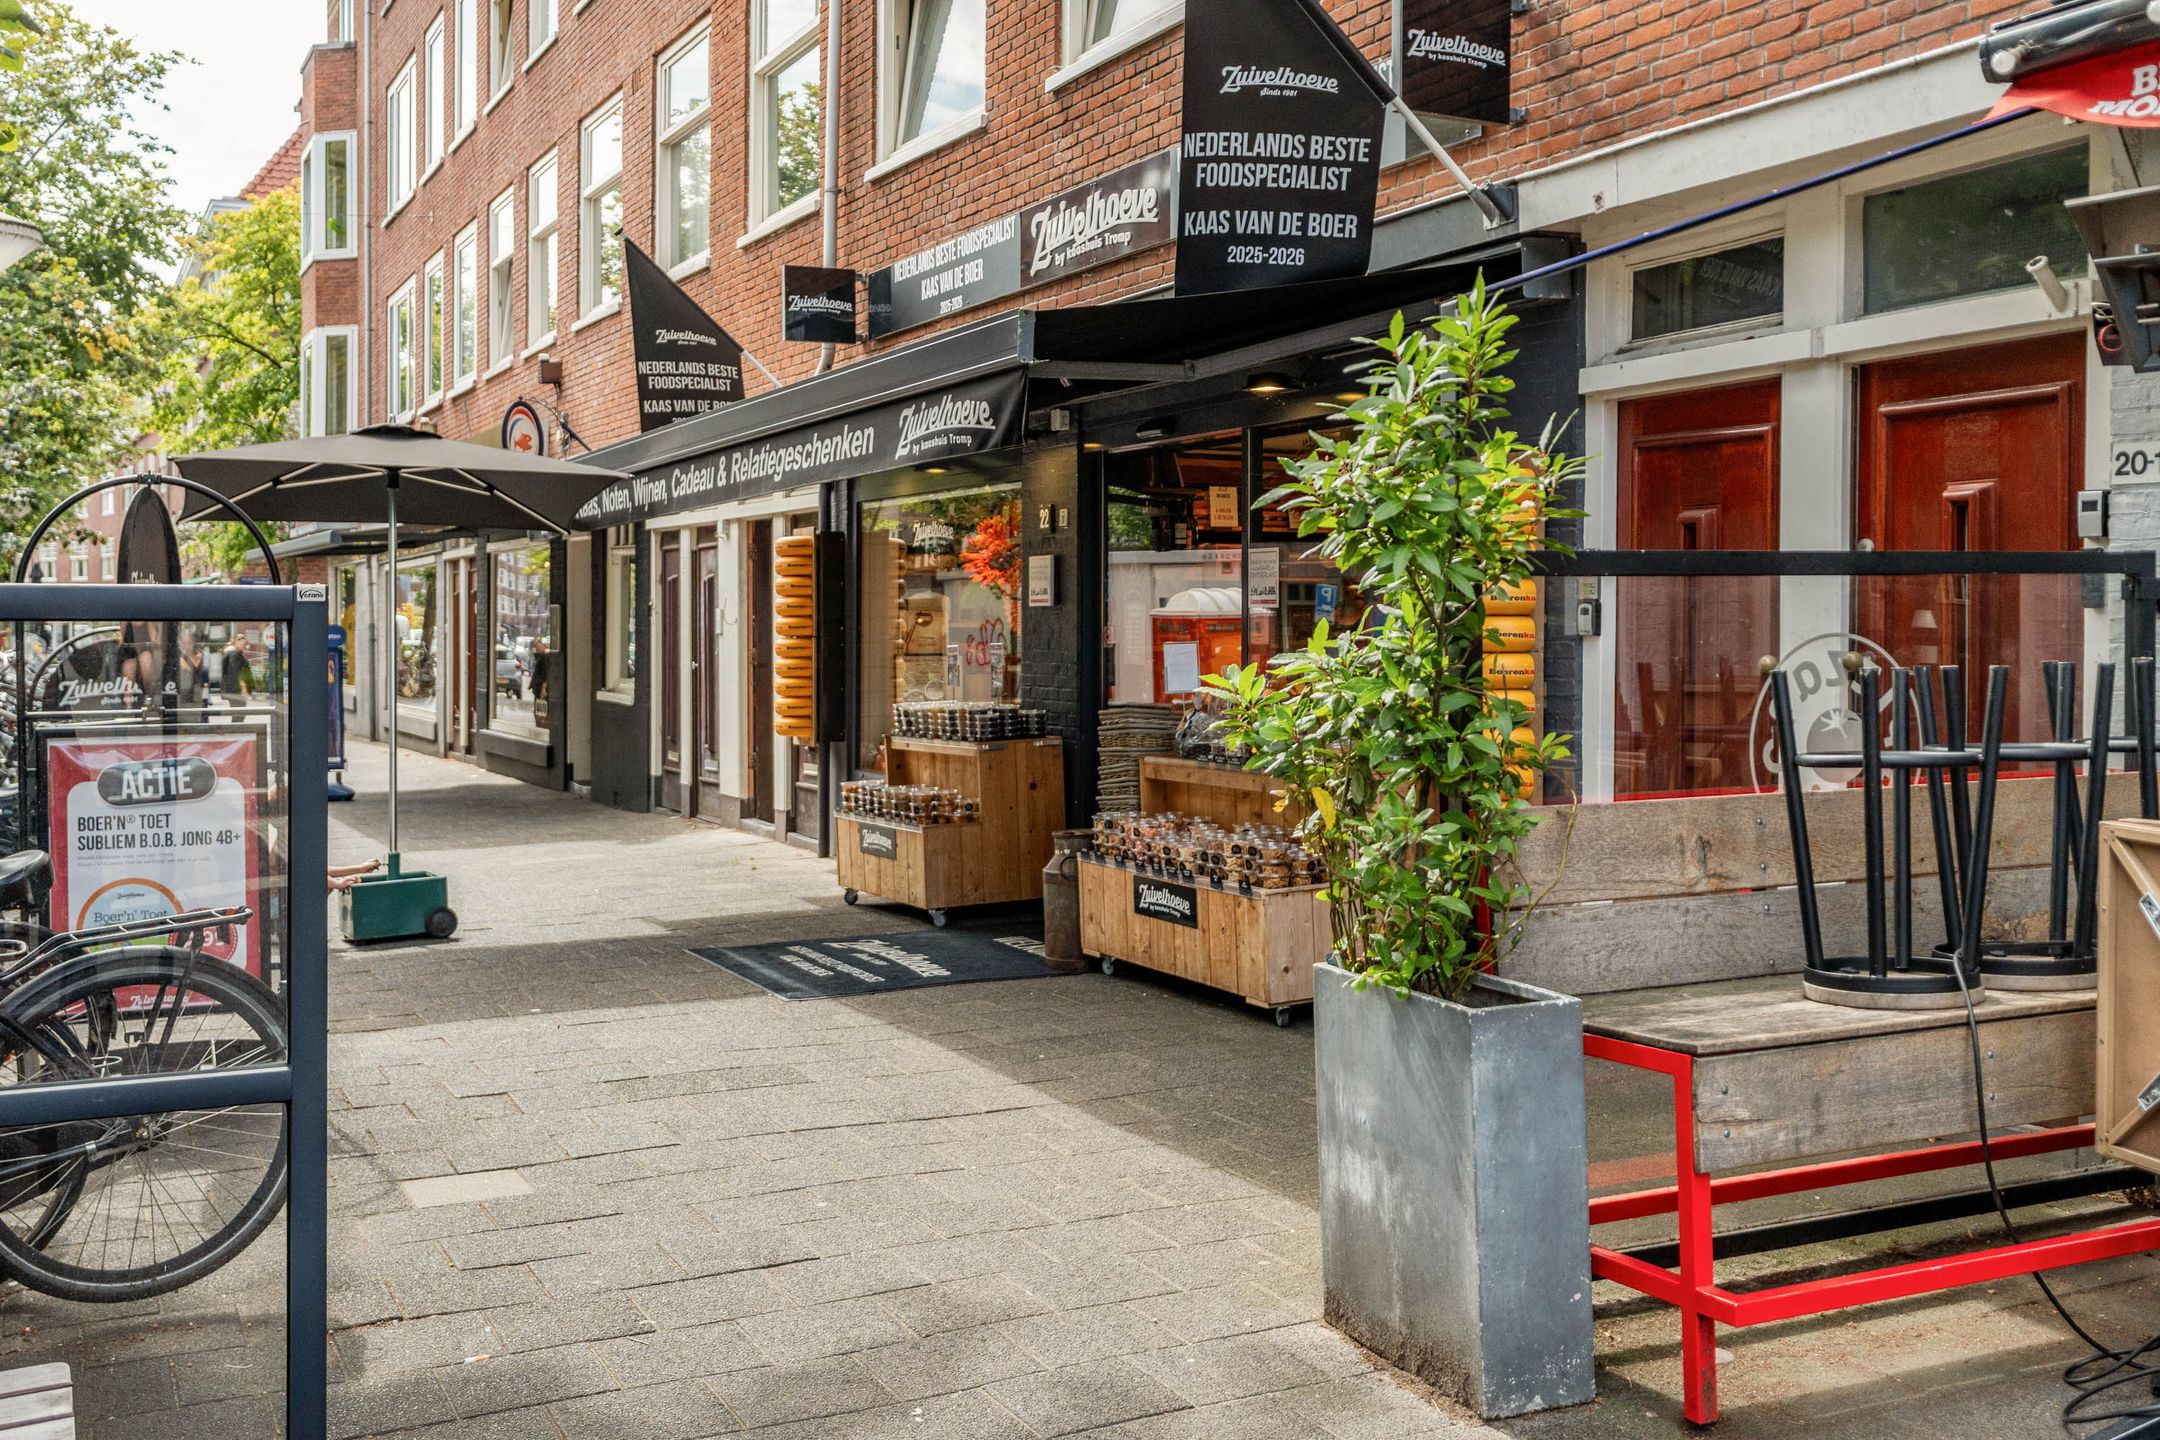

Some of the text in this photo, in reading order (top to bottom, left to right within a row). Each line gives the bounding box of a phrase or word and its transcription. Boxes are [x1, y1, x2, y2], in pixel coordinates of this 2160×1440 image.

[1407, 28, 1506, 67] Zuivelhoeve
[1219, 65, 1339, 94] Zuivelhoeve
[2131, 64, 2160, 97] B
[1184, 131, 1371, 162] NEDERLANDS BESTE
[1196, 162, 1352, 191] FOODSPECIALIST
[1029, 187, 1160, 278] Zuivelhoeve
[1184, 209, 1358, 239] KAAS VAN DE BOER
[894, 215, 1016, 284] NEDERLANDS BESTE FOODSPECIALIST
[1055, 231, 1132, 267] by kaashuis Tromp
[1227, 245, 1305, 266] 2025-2026
[921, 258, 984, 301] KAAS VAN DE BOER
[788, 294, 853, 312] Zuivelhoeve
[655, 328, 717, 346] Zuivelhoeve
[638, 361, 739, 379] NEDERLANDS BESTE
[648, 376, 732, 391] FOODSPECIALIST
[644, 399, 672, 413] KAAS
[673, 399, 695, 412] VAN
[697, 400, 711, 412] DE
[895, 393, 996, 460] Zuivelhoeve
[912, 433, 972, 456] by kaashuis Tromp
[602, 485, 632, 513] Noten,
[633, 477, 668, 512] Wijnen,
[672, 464, 715, 498] Cadeau
[717, 455, 727, 487] &
[730, 424, 875, 484] Relatiegeschenken
[1039, 508, 1050, 529] 22
[299, 589, 324, 600] Verano
[121, 764, 193, 801] ACTIE
[139, 813, 172, 830] TOET
[77, 829, 241, 851] SUBLIEM B.O.B. JONG 48+
[1139, 884, 1191, 916] Zuivelhoeve
